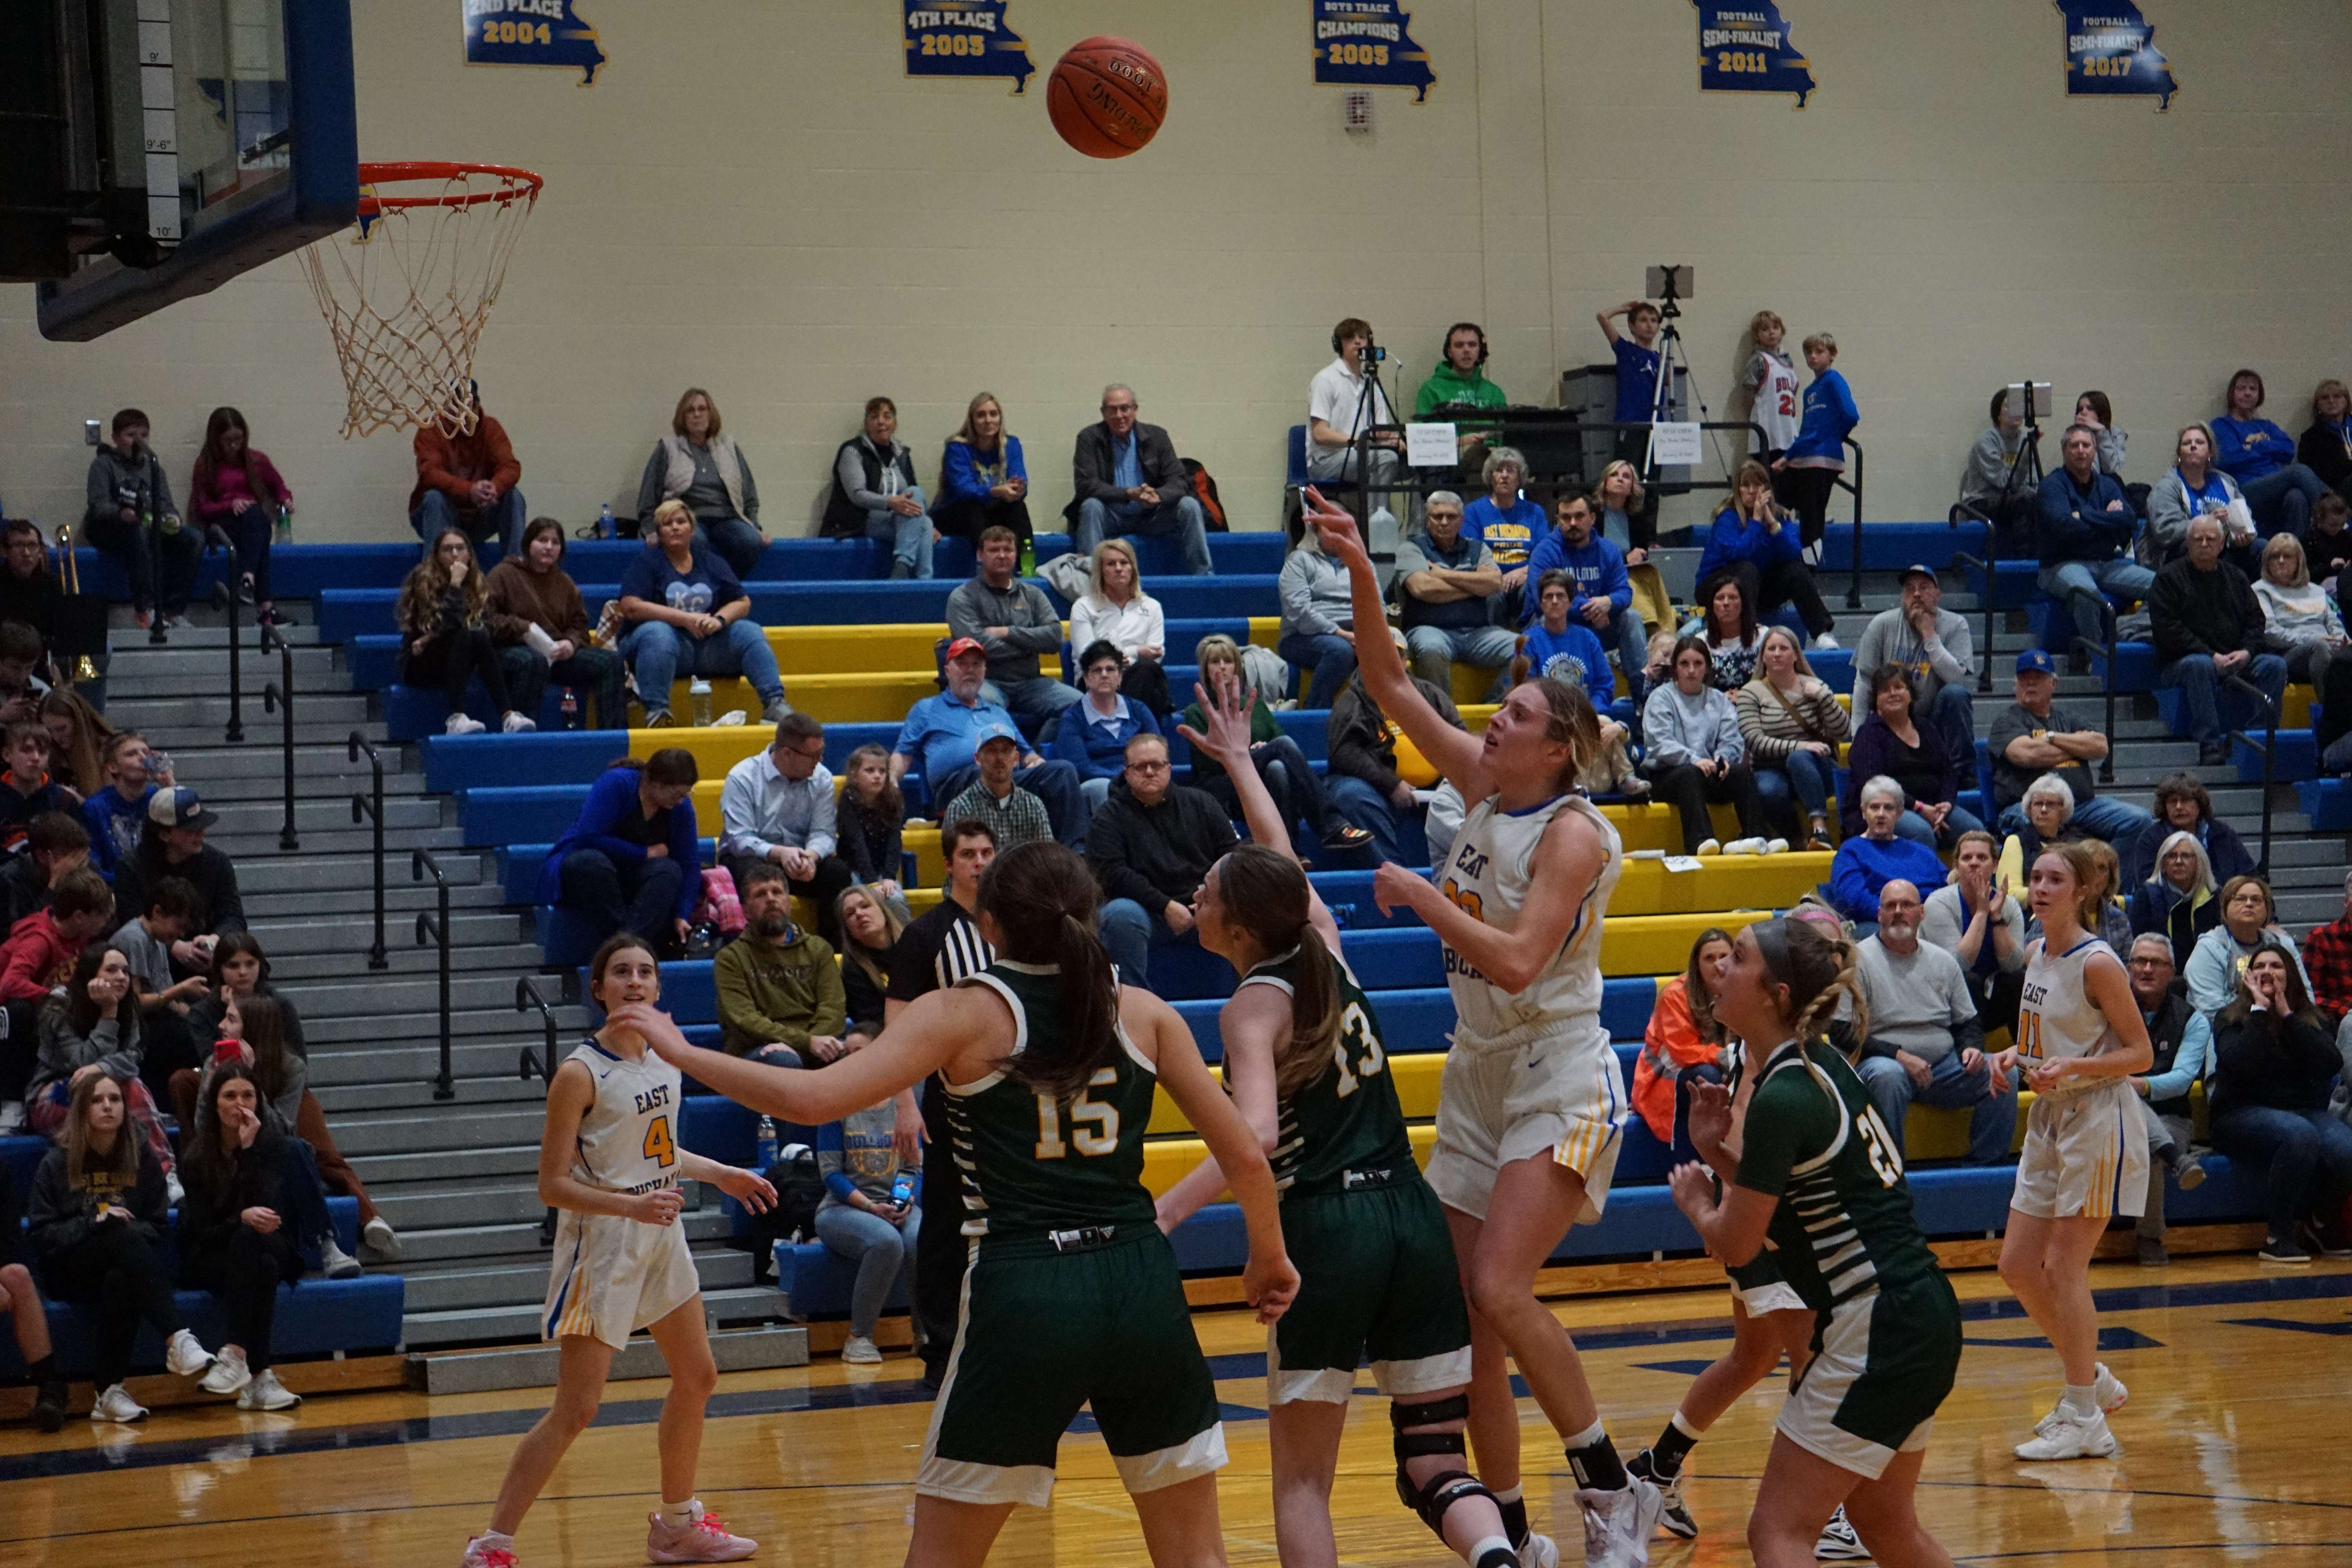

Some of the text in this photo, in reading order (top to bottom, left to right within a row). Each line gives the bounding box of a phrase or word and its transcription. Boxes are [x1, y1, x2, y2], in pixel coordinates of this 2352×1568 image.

[507, 0, 564, 20] PLACE
[1325, 2, 1390, 13] BOYS TRACK
[1717, 11, 1766, 21] FOOTBALL
[908, 11, 996, 33] 4TH PLACE
[1317, 21, 1401, 42] CHAMPIONS
[2083, 17, 2130, 26] FOOTBALL
[483, 21, 552, 45] 2004
[1703, 29, 1782, 50] SEMI-FINALIST
[2070, 34, 2144, 54] SEMI-FINALIST
[921, 34, 985, 56] 2005
[1328, 44, 1389, 66] 2005
[1718, 51, 1767, 73] 2011
[2083, 56, 2132, 76] 2017
[2023, 982, 2048, 1006] EAST
[2018, 1009, 2043, 1060] 11
[1335, 1002, 1384, 1098] 13
[634, 1084, 670, 1114] EAST
[1031, 1067, 1119, 1160] 15
[642, 1114, 675, 1169] 4
